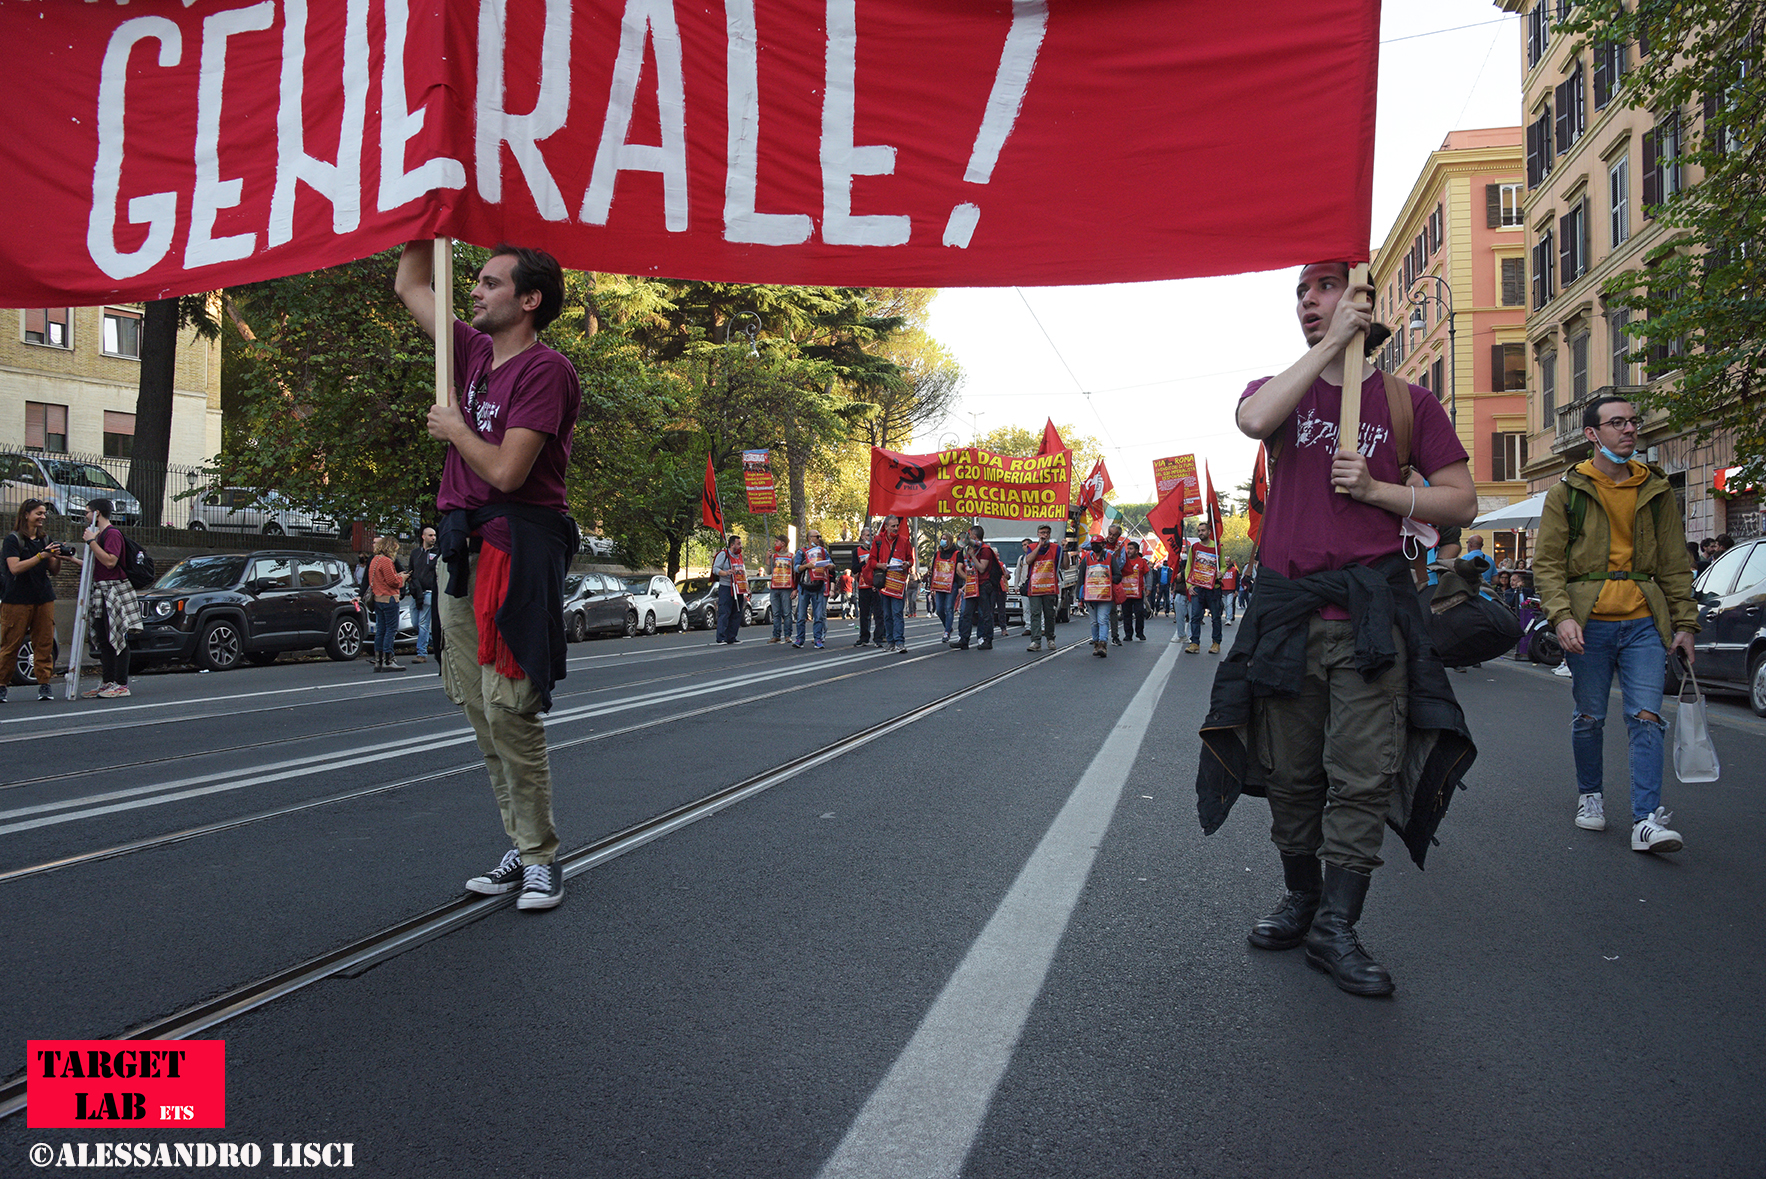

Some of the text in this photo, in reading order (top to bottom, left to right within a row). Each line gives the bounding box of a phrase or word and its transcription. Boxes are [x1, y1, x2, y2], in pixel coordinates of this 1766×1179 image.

[87, 0, 1049, 280] GENERALE!
[937, 450, 1067, 471] VIA DA ROMA
[937, 465, 1067, 485] IL G20 IMPERIALISTA
[951, 485, 1056, 504] CACCIAMO
[938, 499, 1066, 519] IL GOVERNO DRAGHI
